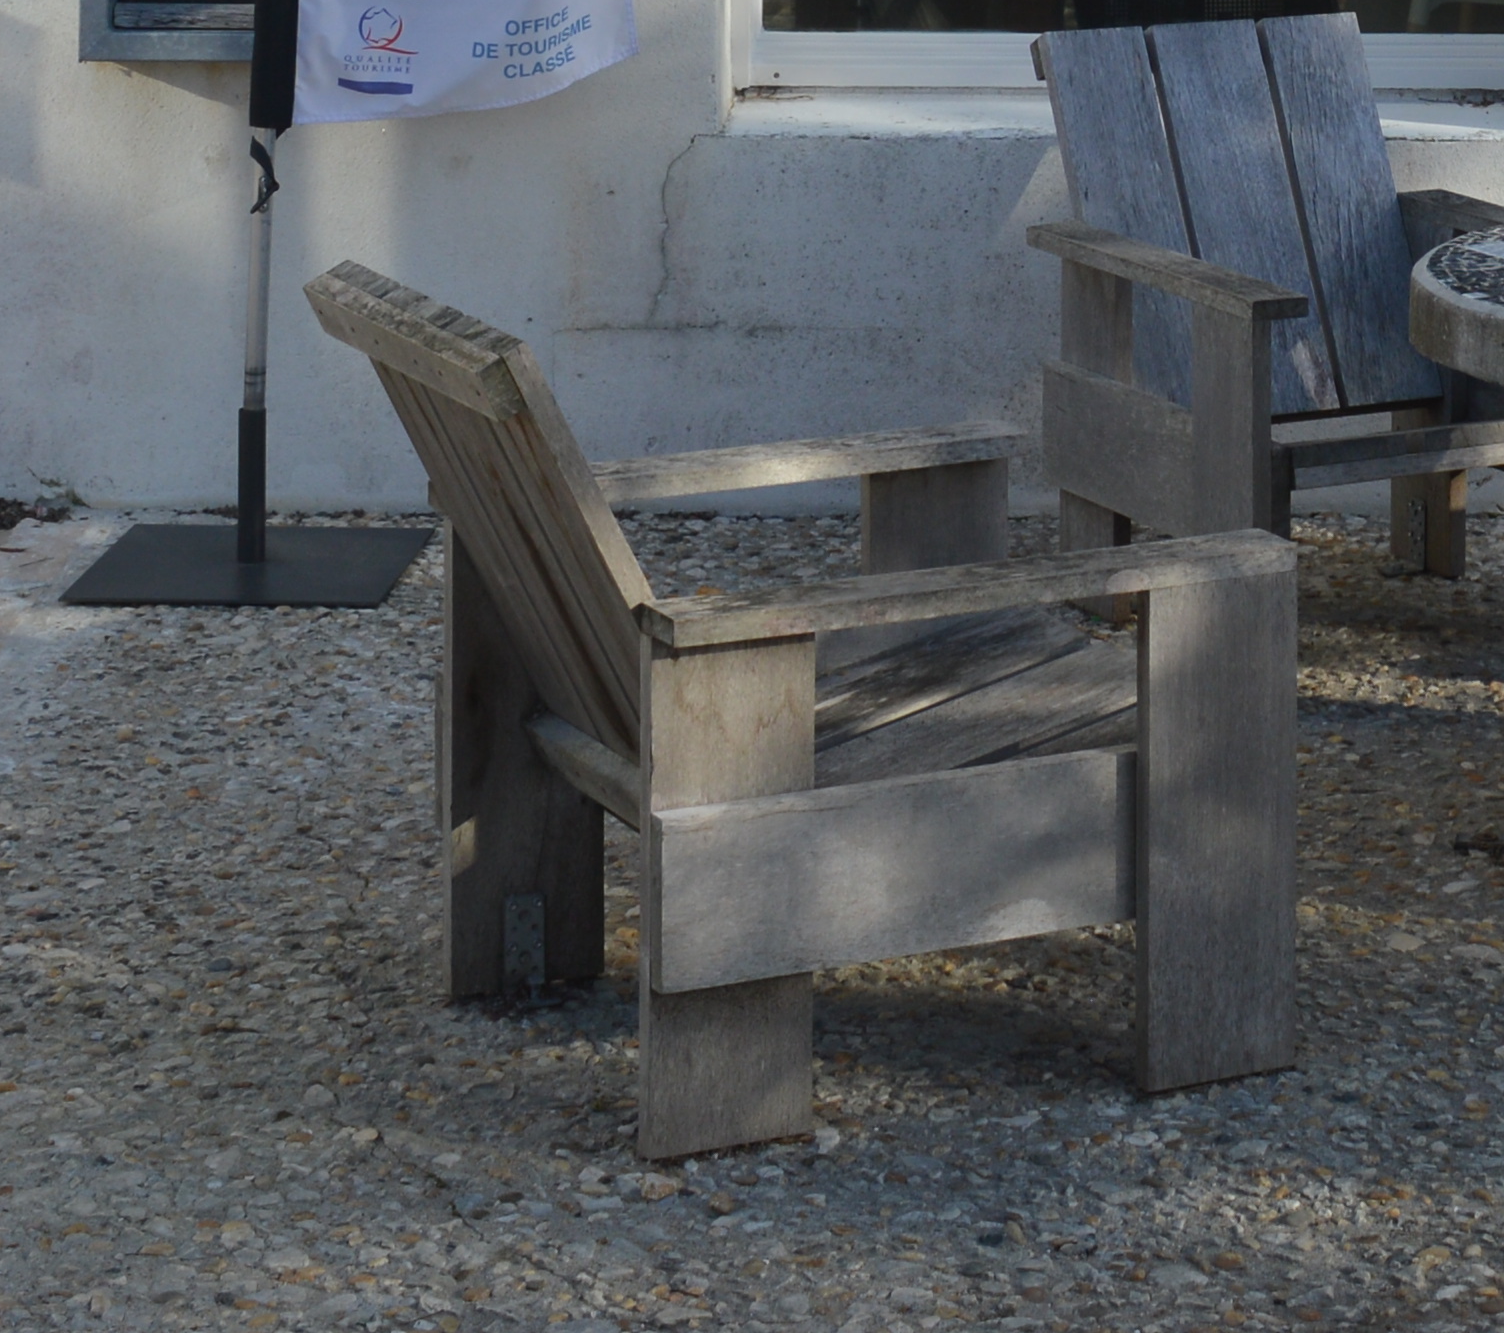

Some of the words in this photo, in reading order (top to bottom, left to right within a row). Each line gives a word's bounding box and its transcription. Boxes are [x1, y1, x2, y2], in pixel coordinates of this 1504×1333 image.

[472, 41, 499, 59] DE
[505, 14, 592, 57] TOURISME
[504, 6, 569, 36] OFFICE
[343, 64, 411, 74] TOURISME
[503, 43, 576, 79] CLASSÉ
